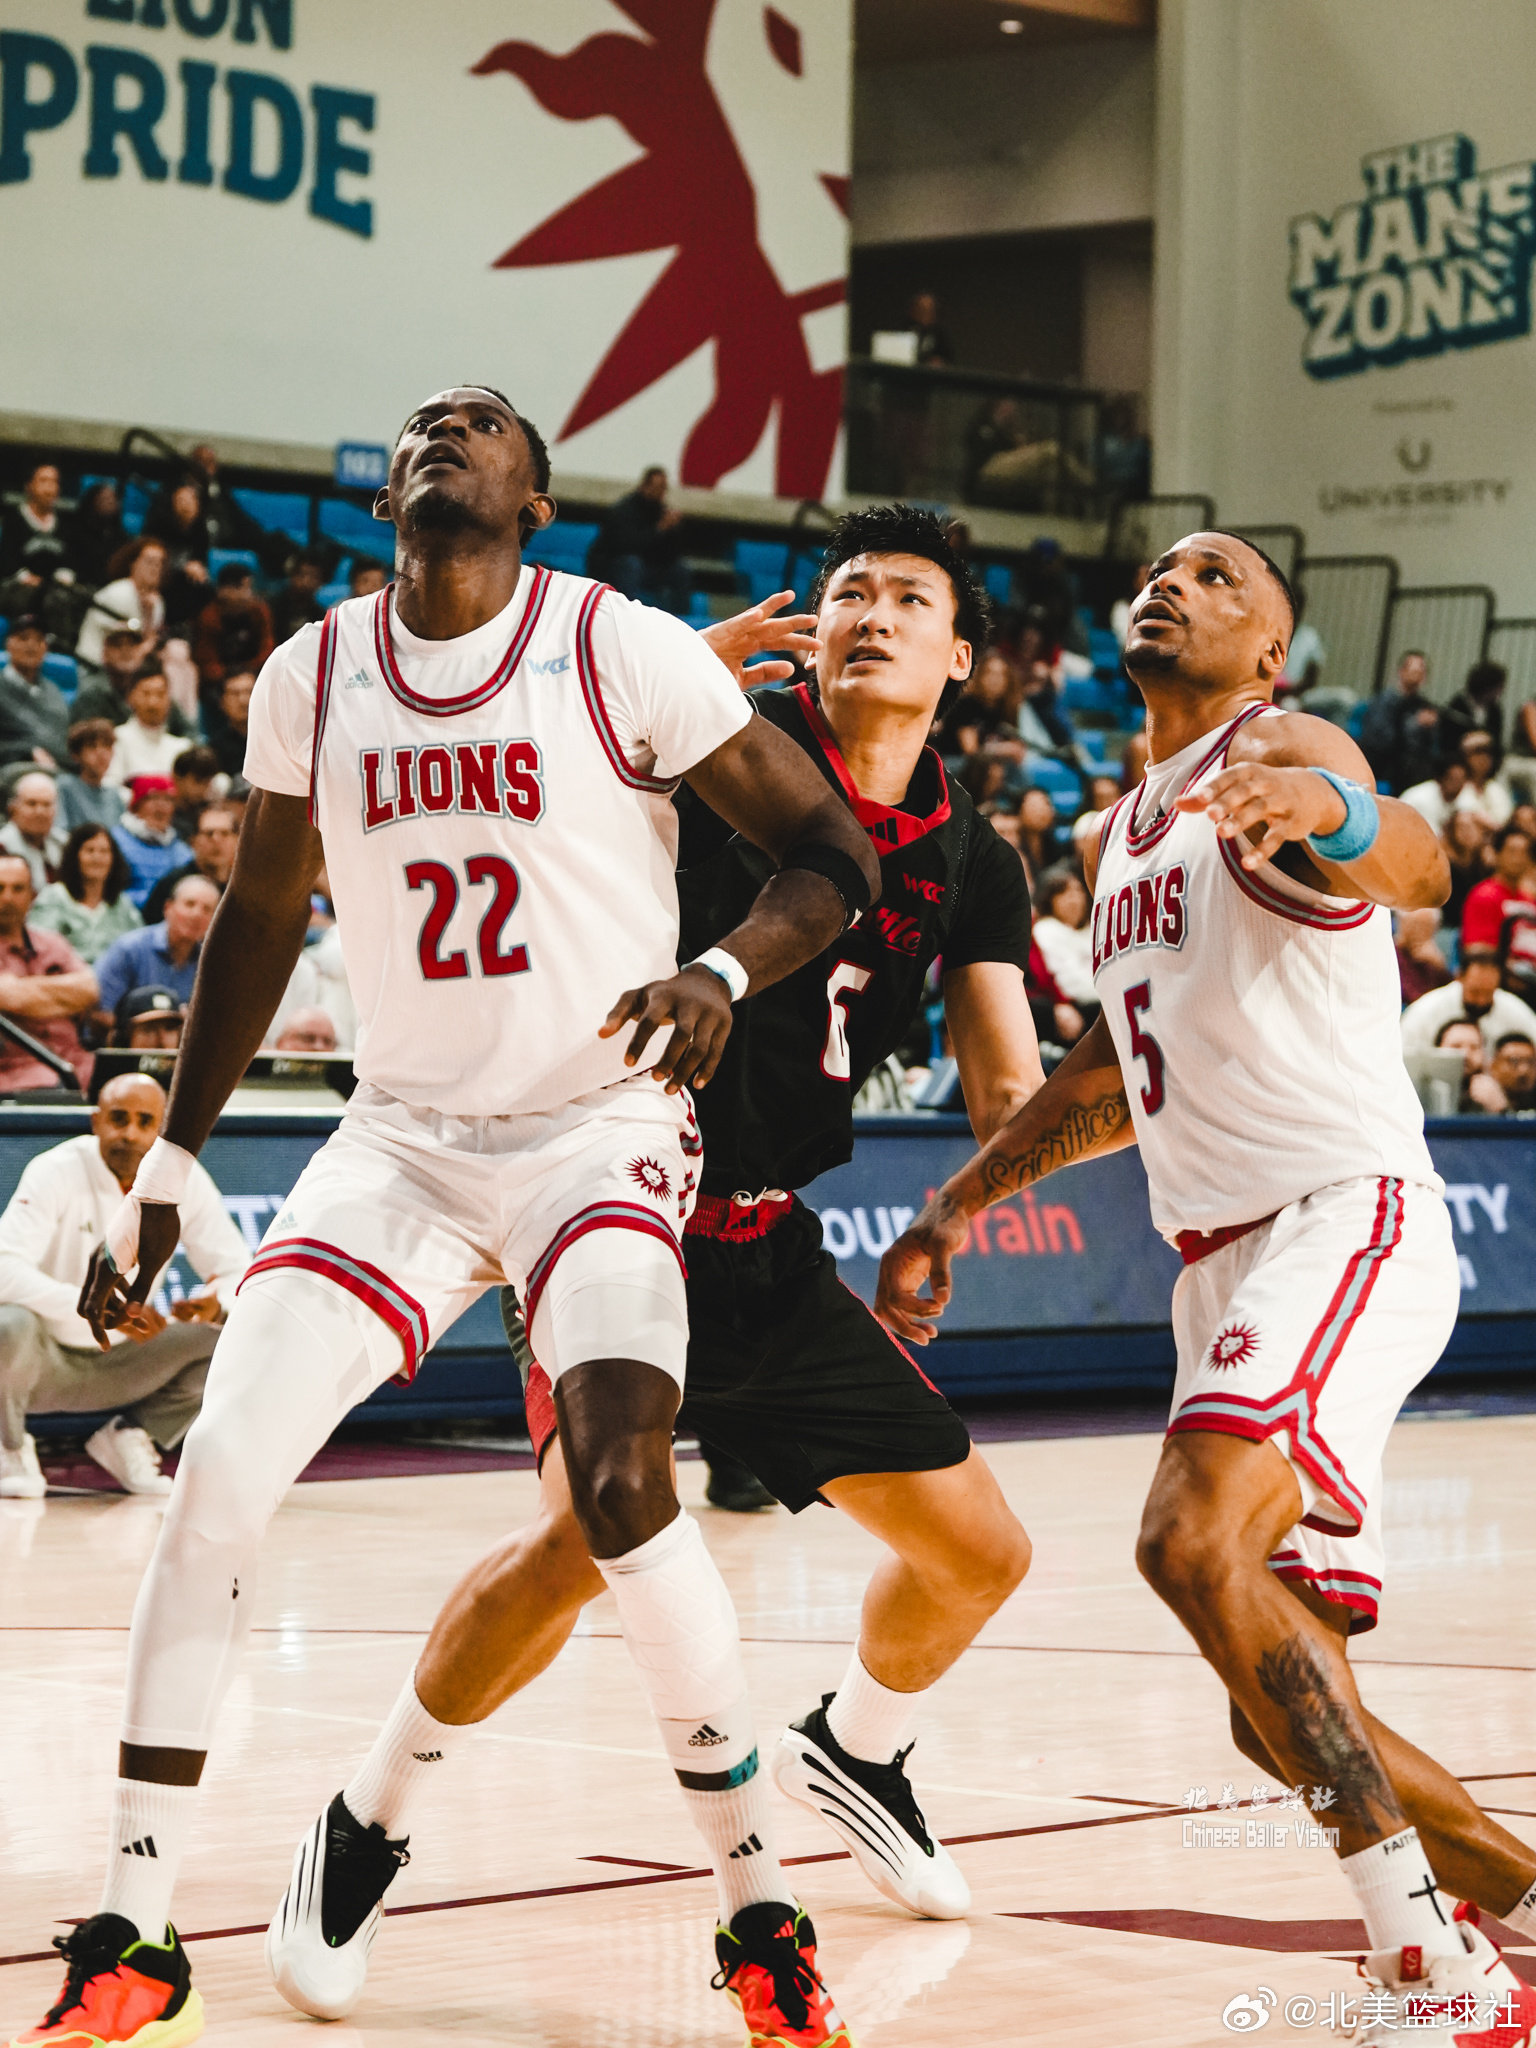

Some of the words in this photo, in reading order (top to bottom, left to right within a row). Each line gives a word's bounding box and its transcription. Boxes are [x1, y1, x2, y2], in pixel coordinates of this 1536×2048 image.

[86, 0, 294, 51] ON
[0, 29, 378, 240] PRIDE
[1366, 141, 1458, 196] THE
[1295, 167, 1532, 288] MANE
[360, 737, 545, 834] LIONS
[404, 853, 532, 982] 22
[902, 871, 945, 905] WCC
[1091, 860, 1189, 988] LIONS
[1123, 978, 1165, 1118] 5
[989, 1100, 1125, 1195] Sacrifice
[808, 1204, 917, 1261] our
[923, 1186, 1085, 1257] rain
